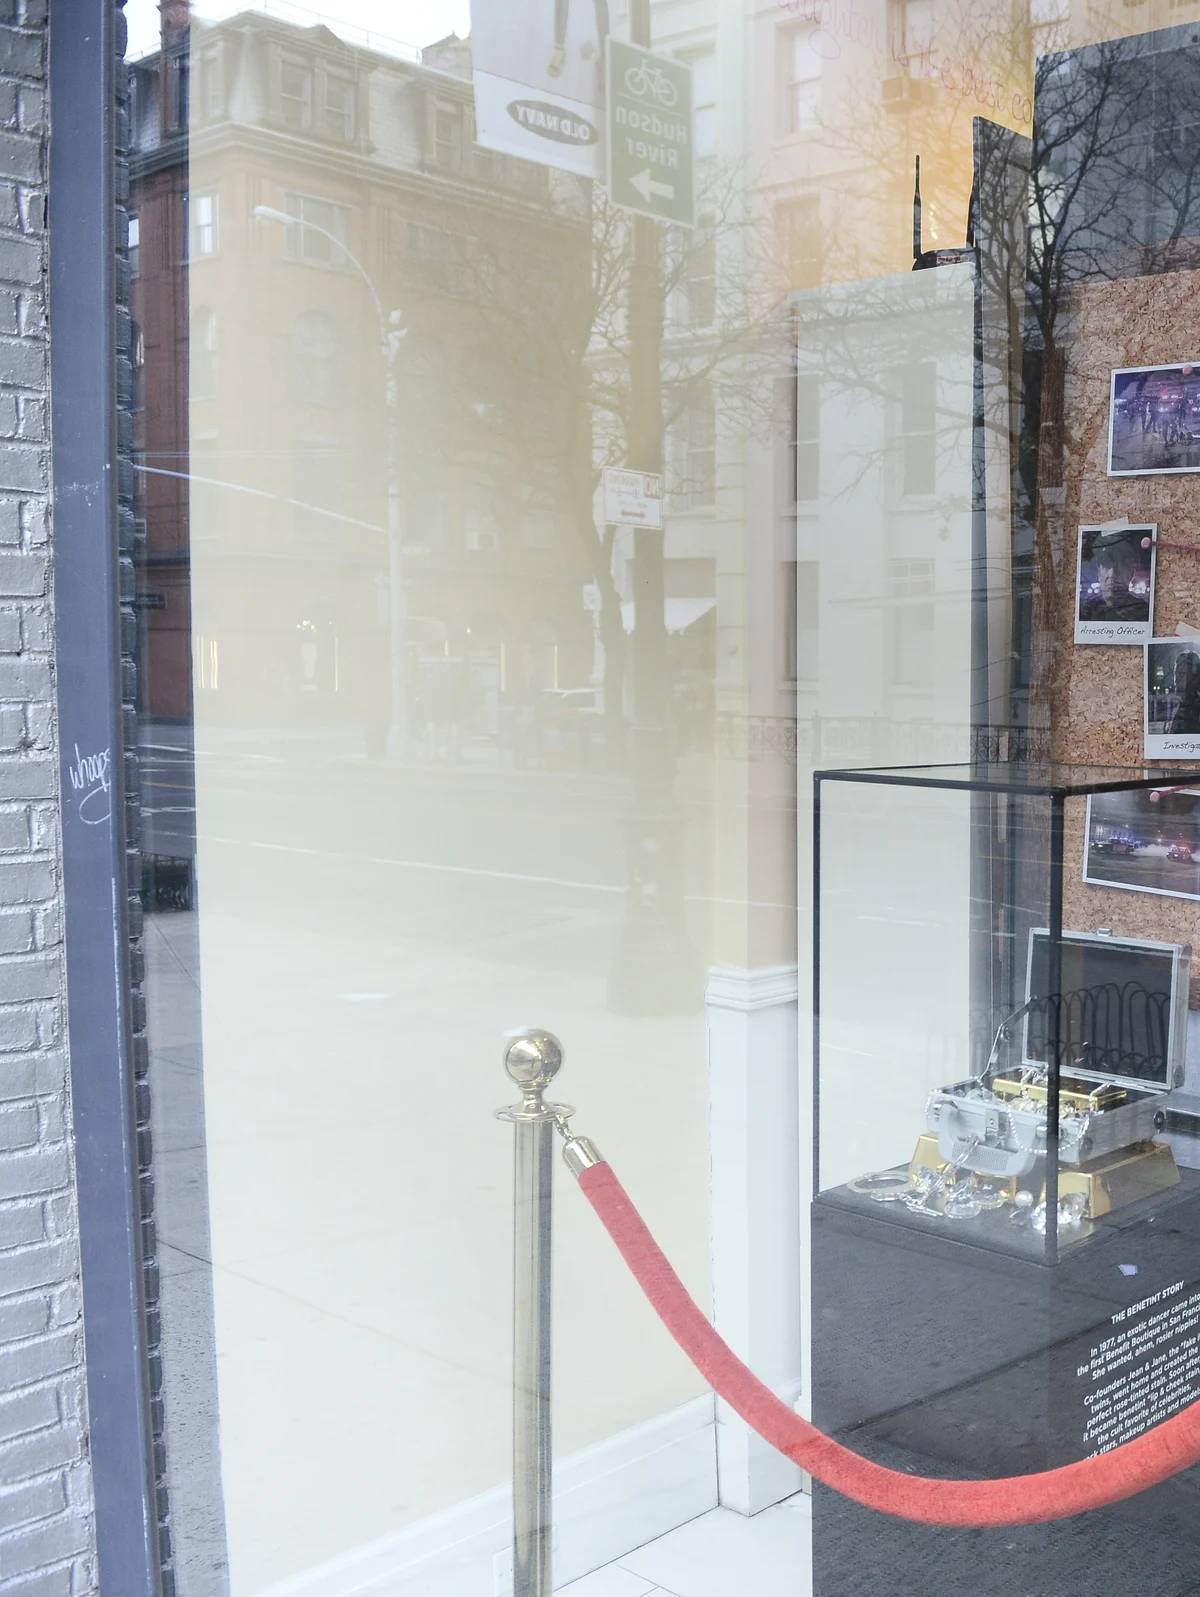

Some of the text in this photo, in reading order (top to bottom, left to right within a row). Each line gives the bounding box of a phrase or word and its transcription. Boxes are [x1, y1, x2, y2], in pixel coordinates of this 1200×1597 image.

[1080, 625, 1146, 639] Arresting Officer
[1090, 1293, 1200, 1358] In 1977, an exotic dancer came into
[1111, 1280, 1184, 1325] THE BENETINT STORY
[1077, 1365, 1089, 1377] the
[1090, 1354, 1105, 1370] first
[1105, 1341, 1130, 1361] Benefit
[1131, 1325, 1161, 1347] Boutique
[1161, 1321, 1168, 1331] in
[1169, 1315, 1181, 1327] San
[1083, 1376, 1127, 1406] Co-founders
[1127, 1367, 1144, 1381] Jean
[1144, 1362, 1150, 1371] &
[1151, 1354, 1168, 1368] Jane,
[1168, 1346, 1180, 1358] the
[1092, 1314, 1199, 1380] She wanted, ahem, rosier nipples!
[1083, 1432, 1089, 1442] it
[1090, 1417, 1118, 1438] became
[1118, 1398, 1146, 1421] benetint
[1159, 1386, 1165, 1396] &
[1165, 1375, 1184, 1392] cheek
[1086, 1406, 1112, 1430] perfect
[1113, 1383, 1150, 1413] rose-tinted
[1150, 1376, 1168, 1391] stain.
[1168, 1365, 1185, 1381] Soon
[1091, 1346, 1199, 1414] twins, went home and created the
[1097, 1383, 1192, 1445] the cult favorite of celebrities,
[1099, 1440, 1118, 1455] stars,
[1119, 1422, 1146, 1443] makeup
[1146, 1409, 1166, 1426] artists
[1167, 1399, 1180, 1414] and
